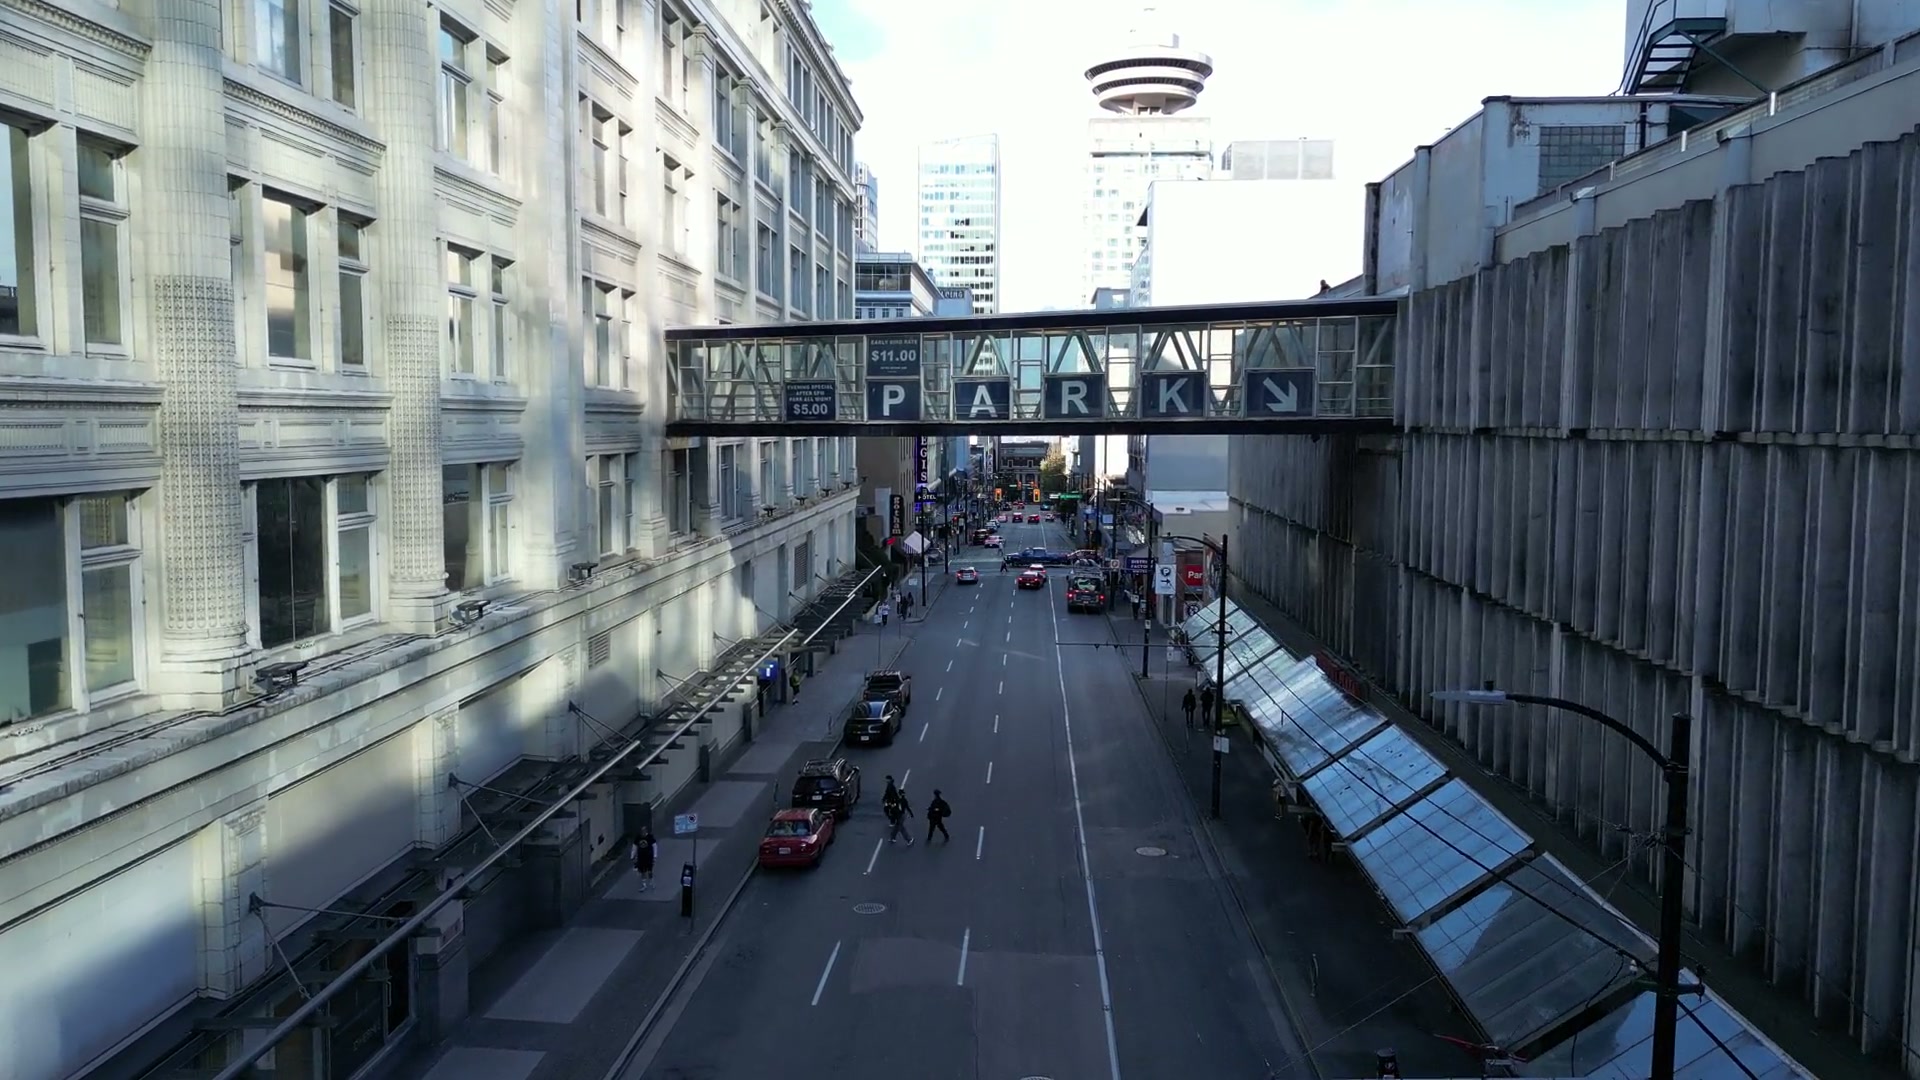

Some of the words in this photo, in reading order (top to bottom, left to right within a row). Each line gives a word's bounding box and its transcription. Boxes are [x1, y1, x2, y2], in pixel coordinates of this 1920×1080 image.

[871, 350, 916, 361] $11.00
[793, 403, 828, 415] $5.00
[883, 378, 1188, 417] PARK
[892, 497, 901, 534] gotham
